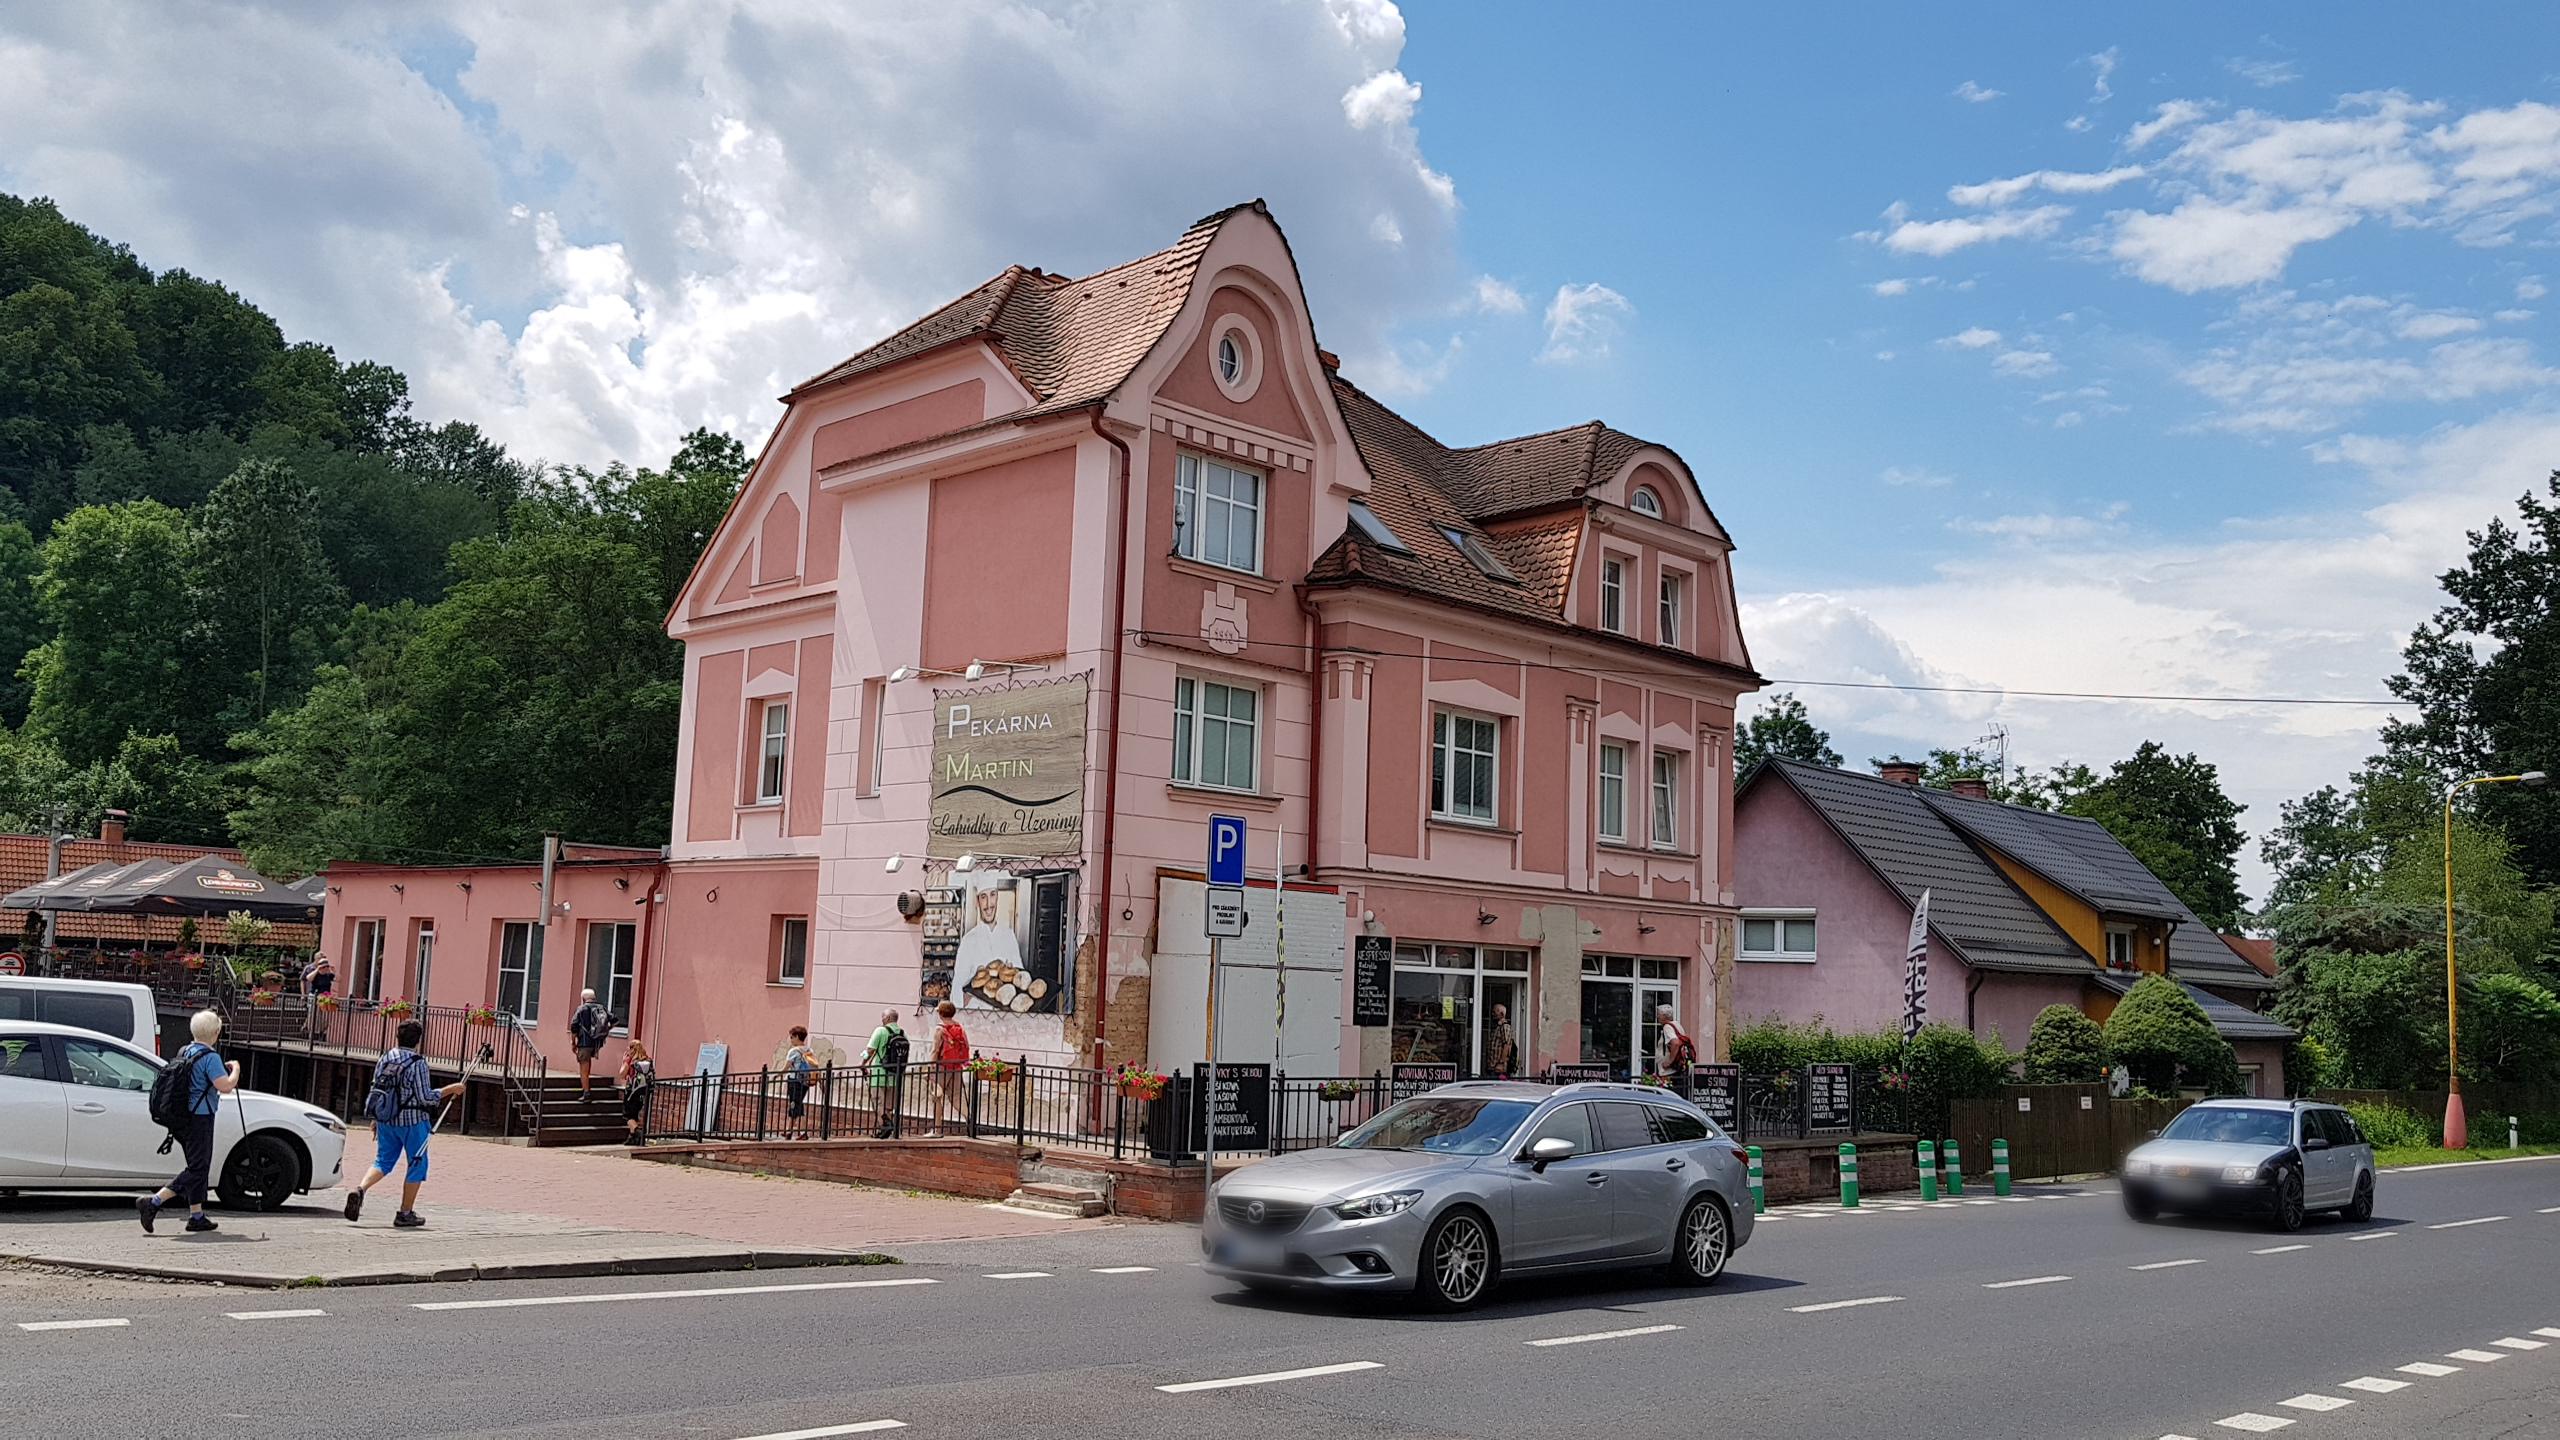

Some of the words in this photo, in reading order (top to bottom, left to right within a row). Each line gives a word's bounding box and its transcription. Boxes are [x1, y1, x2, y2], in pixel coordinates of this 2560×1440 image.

[947, 704, 1053, 739] PEKÁRNA
[945, 753, 1033, 783] MARTIN
[999, 820, 1009, 833] a
[1013, 809, 1080, 833] Uzeniny
[1217, 824, 1238, 863] P
[1232, 1068, 1239, 1078] S
[1397, 1067, 1428, 1080] NOVINKA
[1429, 1068, 1434, 1080] S
